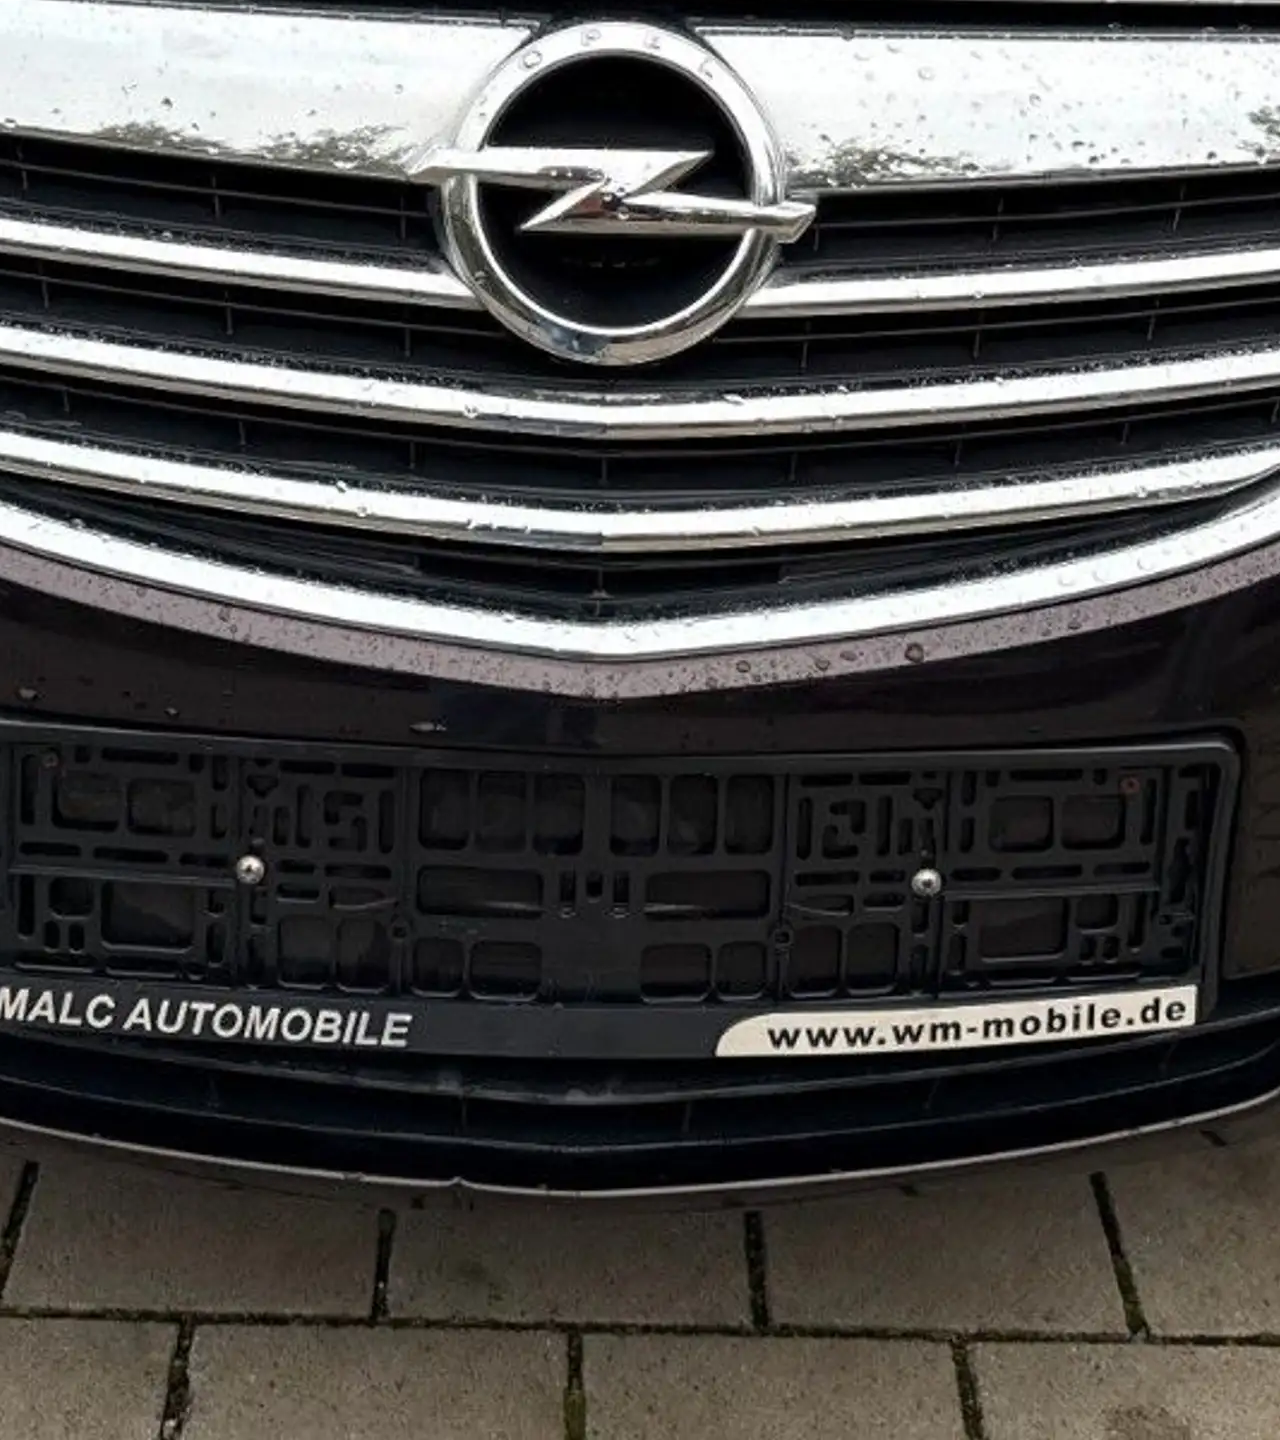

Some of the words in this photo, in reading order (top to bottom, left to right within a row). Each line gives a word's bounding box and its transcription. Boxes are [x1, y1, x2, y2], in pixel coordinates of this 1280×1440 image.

[523, 27, 717, 80] OPEL
[122, 996, 413, 1048] AUTOMOBILE
[767, 997, 1187, 1049] www.wm-mobile.de
